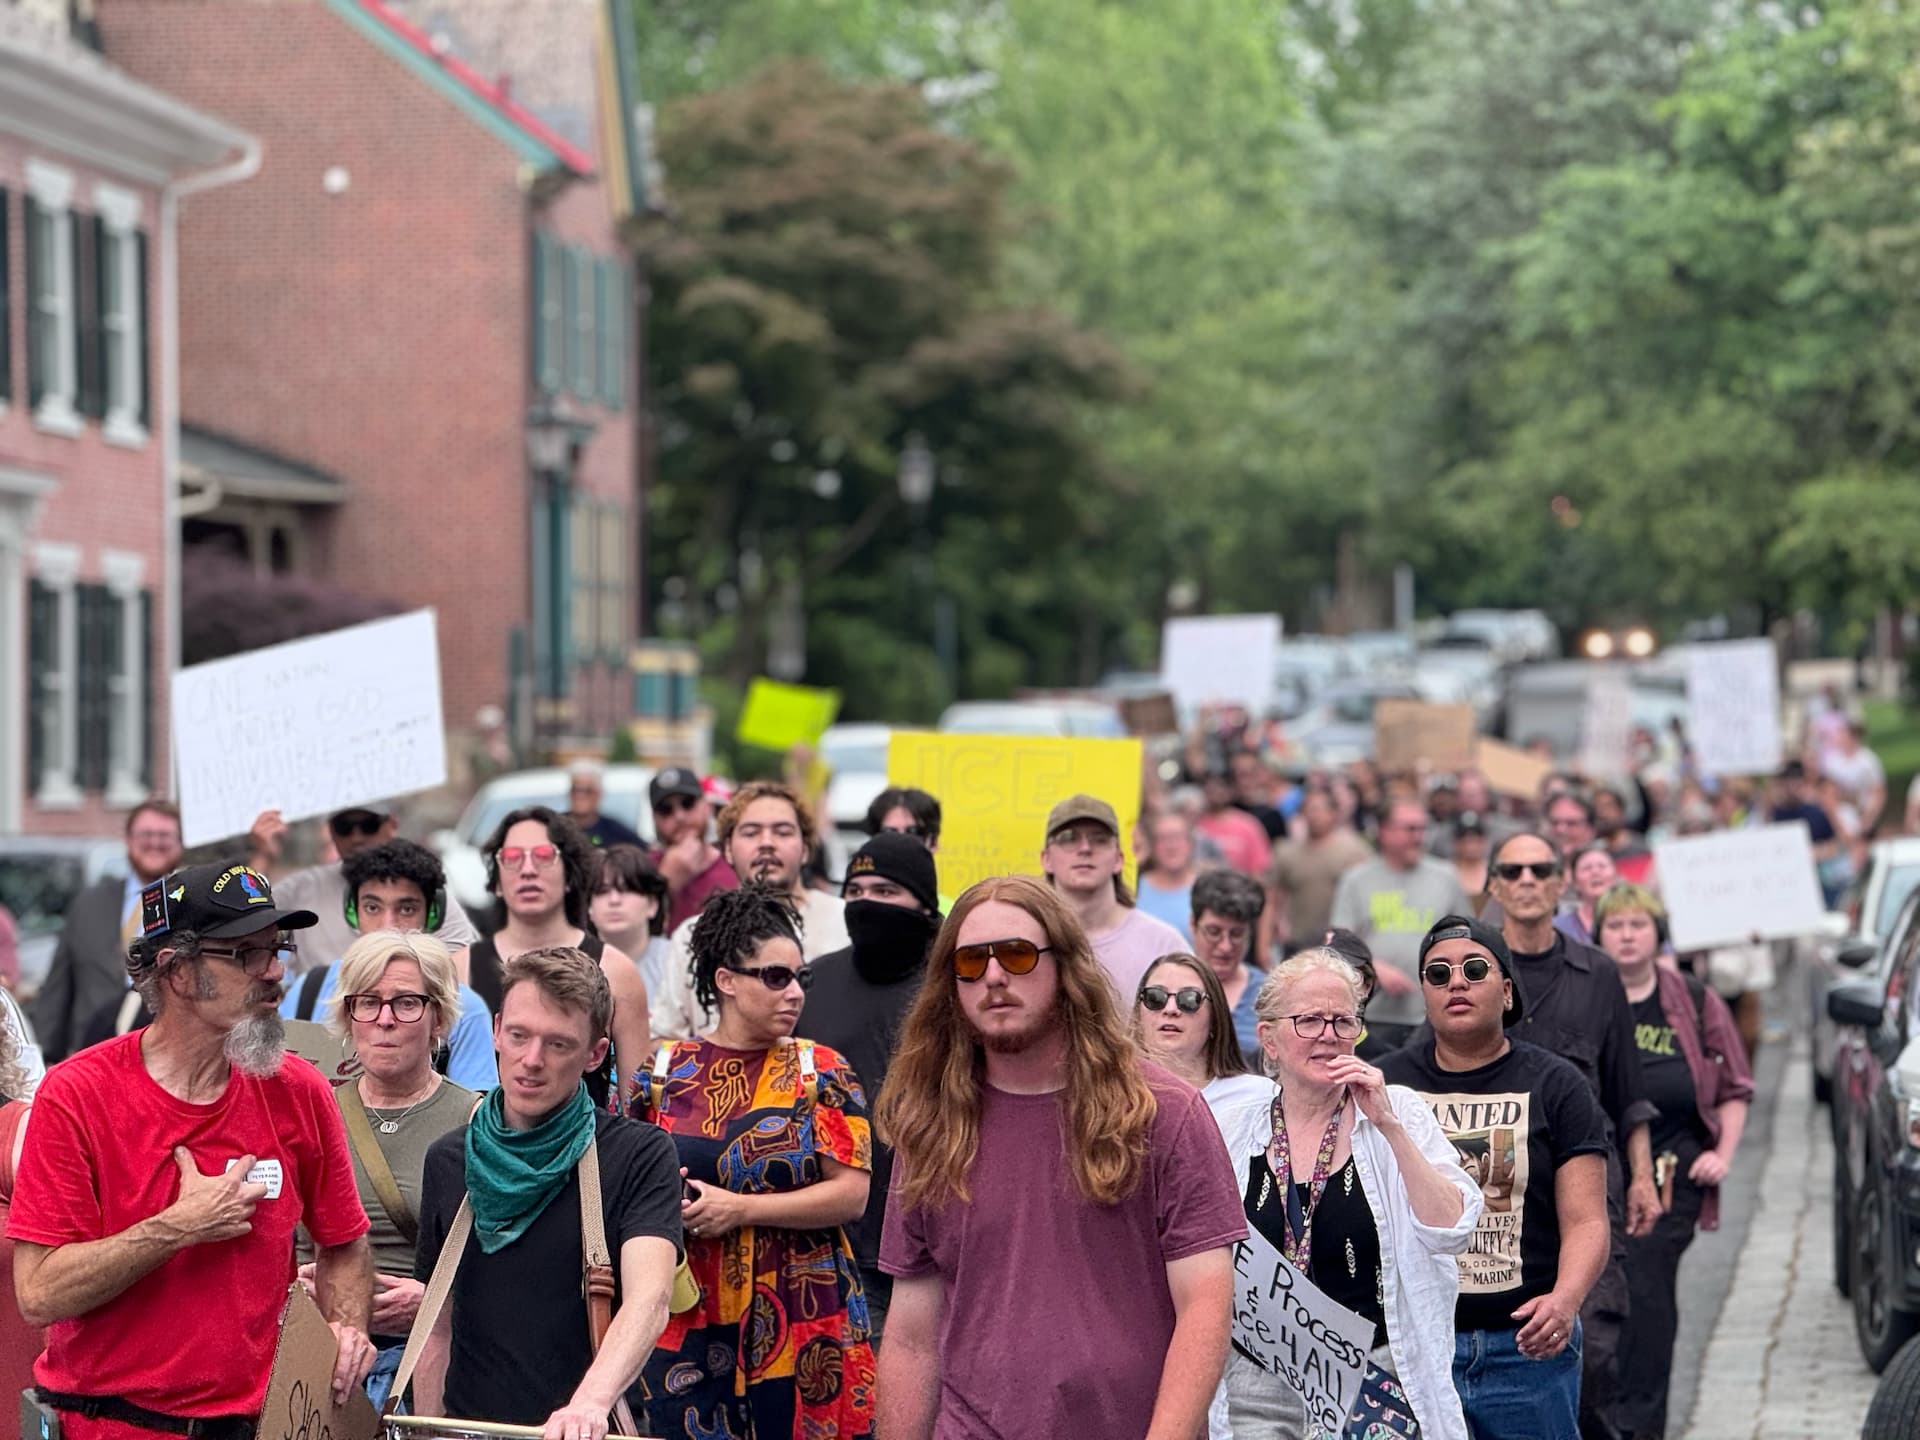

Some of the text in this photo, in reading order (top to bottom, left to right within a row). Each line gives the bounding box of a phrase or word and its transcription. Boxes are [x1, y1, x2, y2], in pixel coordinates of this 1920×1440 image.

[188, 668, 251, 725] ONE
[216, 705, 300, 754] UNDER
[316, 685, 384, 727] GOD
[917, 746, 1074, 819] ICE
[213, 872, 231, 893] COLD
[1428, 1101, 1521, 1130] ANTED
[1476, 1215, 1511, 1229] LIVE
[1234, 1241, 1254, 1278] E
[1473, 1269, 1514, 1285] MARINE
[1281, 1325, 1297, 1366] 4
[1303, 1347, 1346, 1415] ALL
